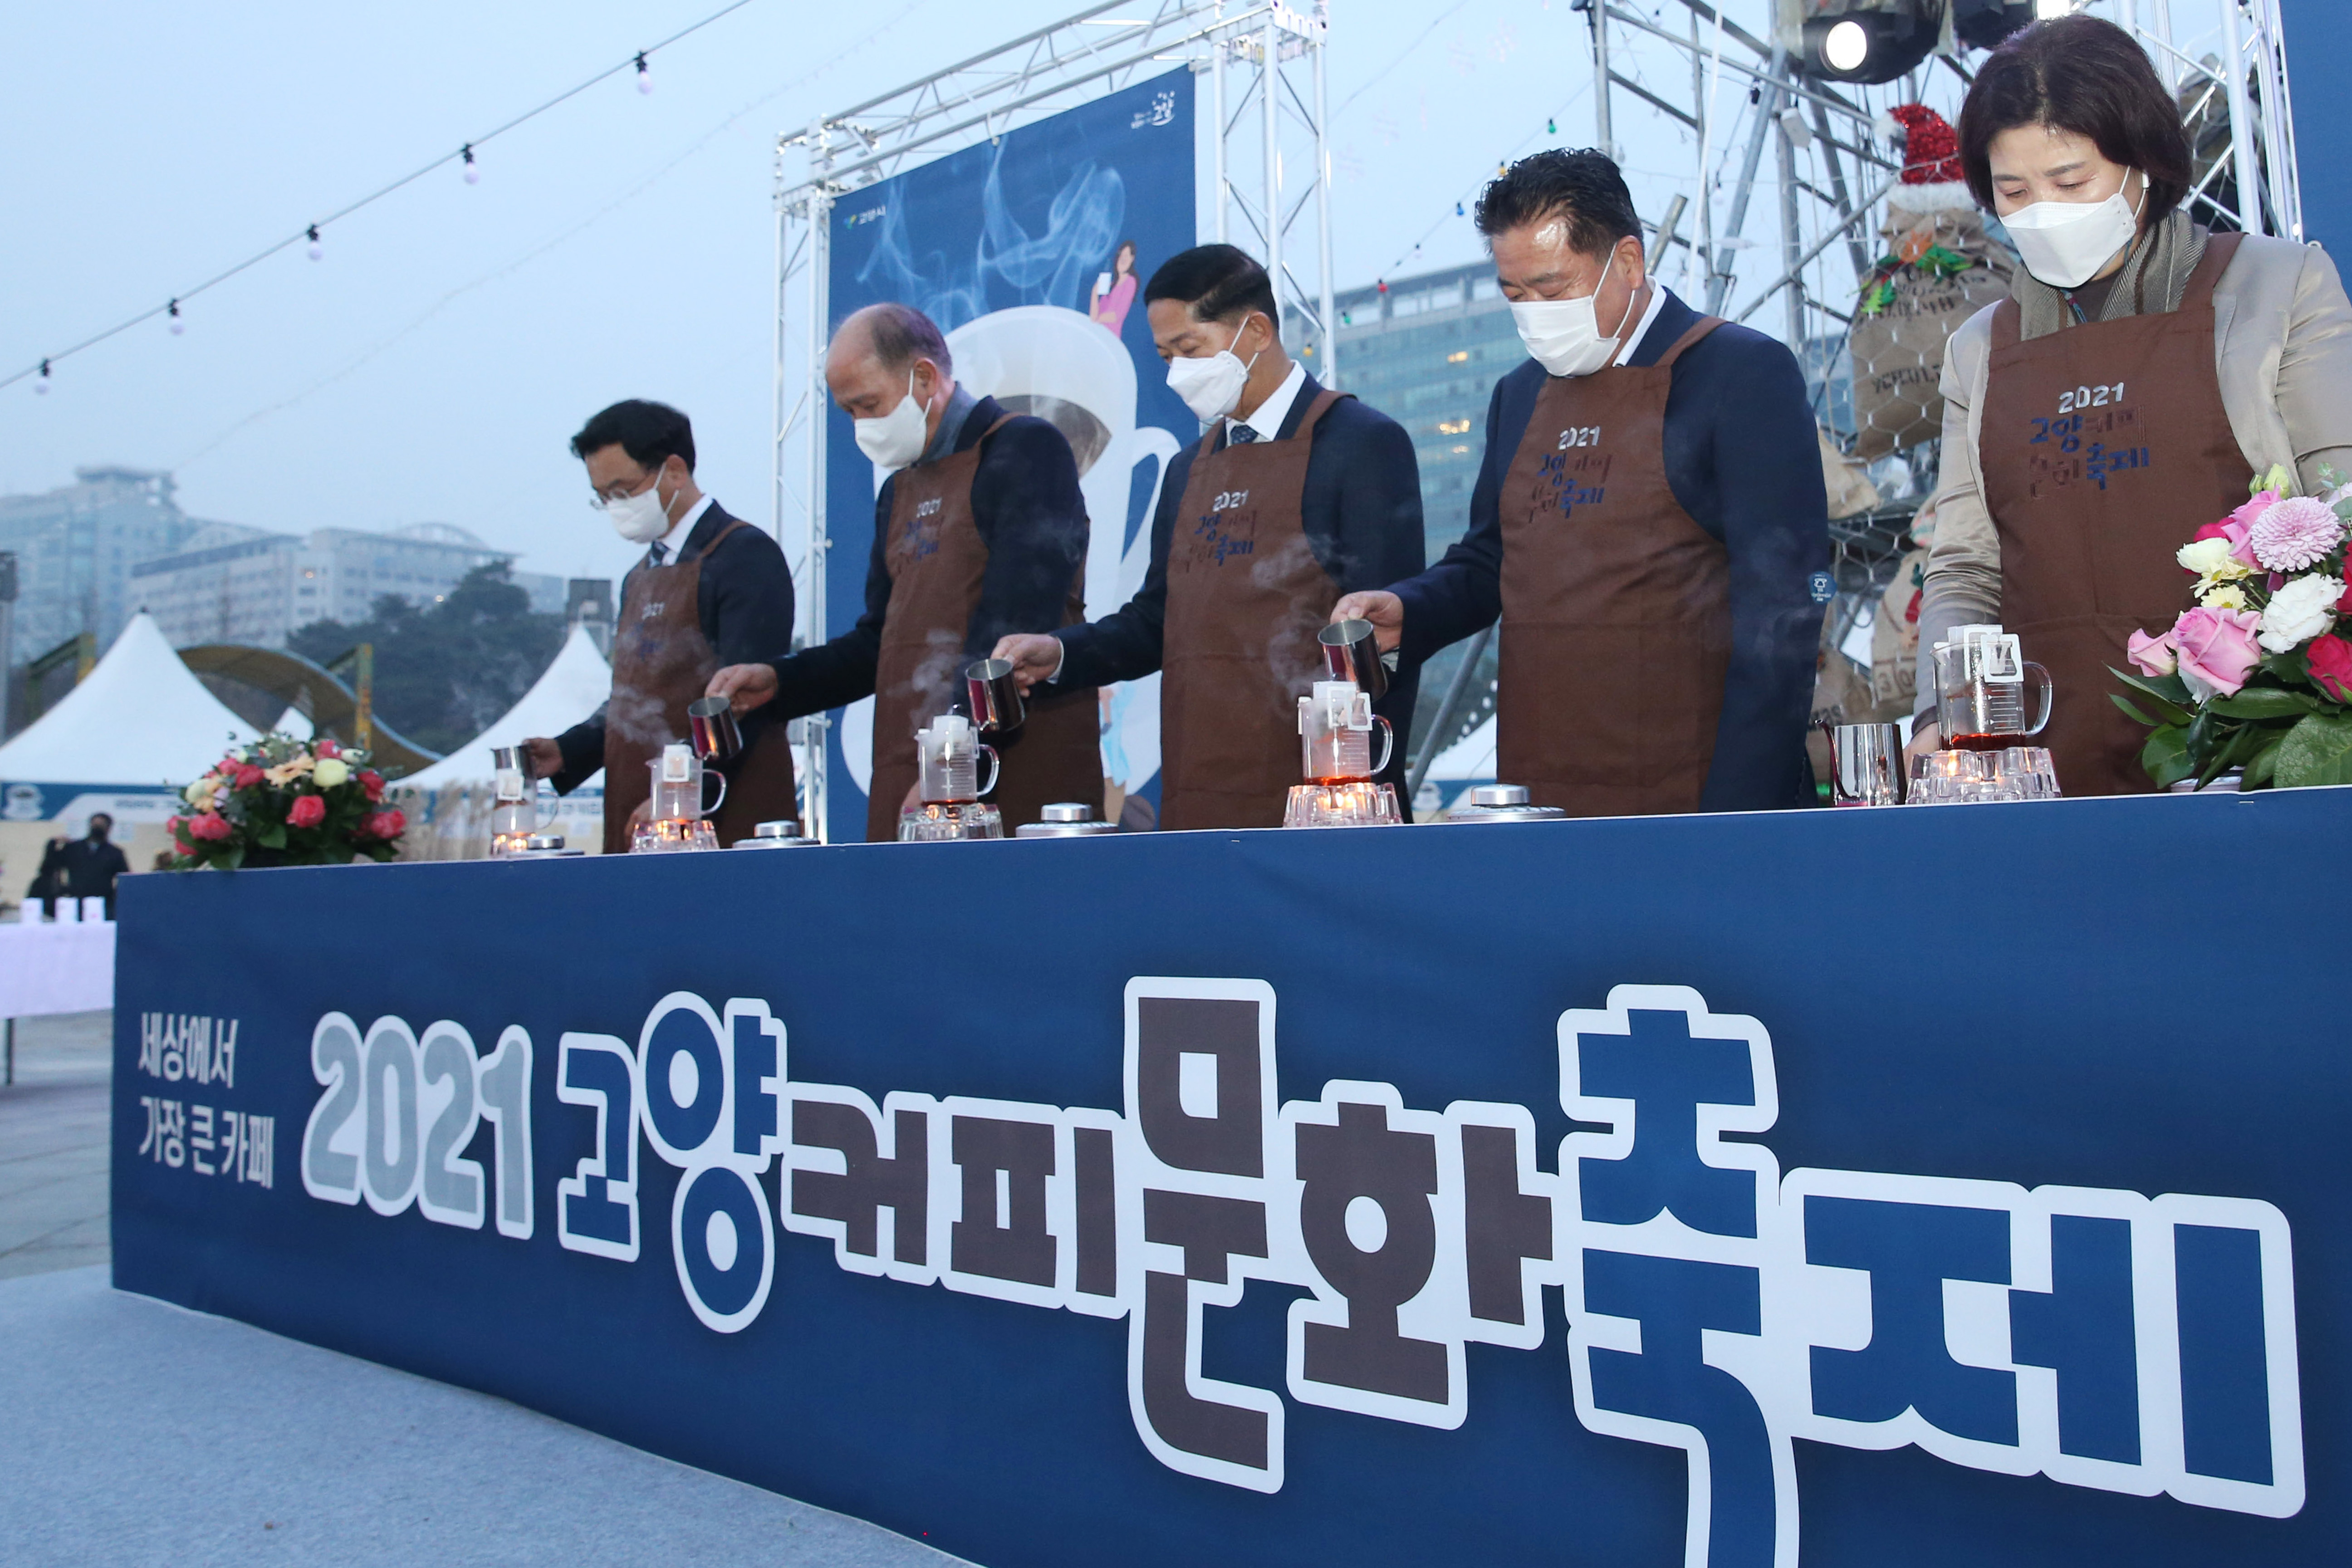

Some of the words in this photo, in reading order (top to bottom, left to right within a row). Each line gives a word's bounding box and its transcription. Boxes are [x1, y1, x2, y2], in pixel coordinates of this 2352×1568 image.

[2058, 382, 2124, 414] 2021
[1558, 426, 1600, 450] 2021
[1212, 489, 1249, 513] 2021
[138, 1012, 239, 1088] 세상에서
[138, 1096, 185, 1168] 가장
[191, 1105, 216, 1176] 큰
[220, 1109, 275, 1189] 카페
[301, 1011, 534, 1240] 2021
